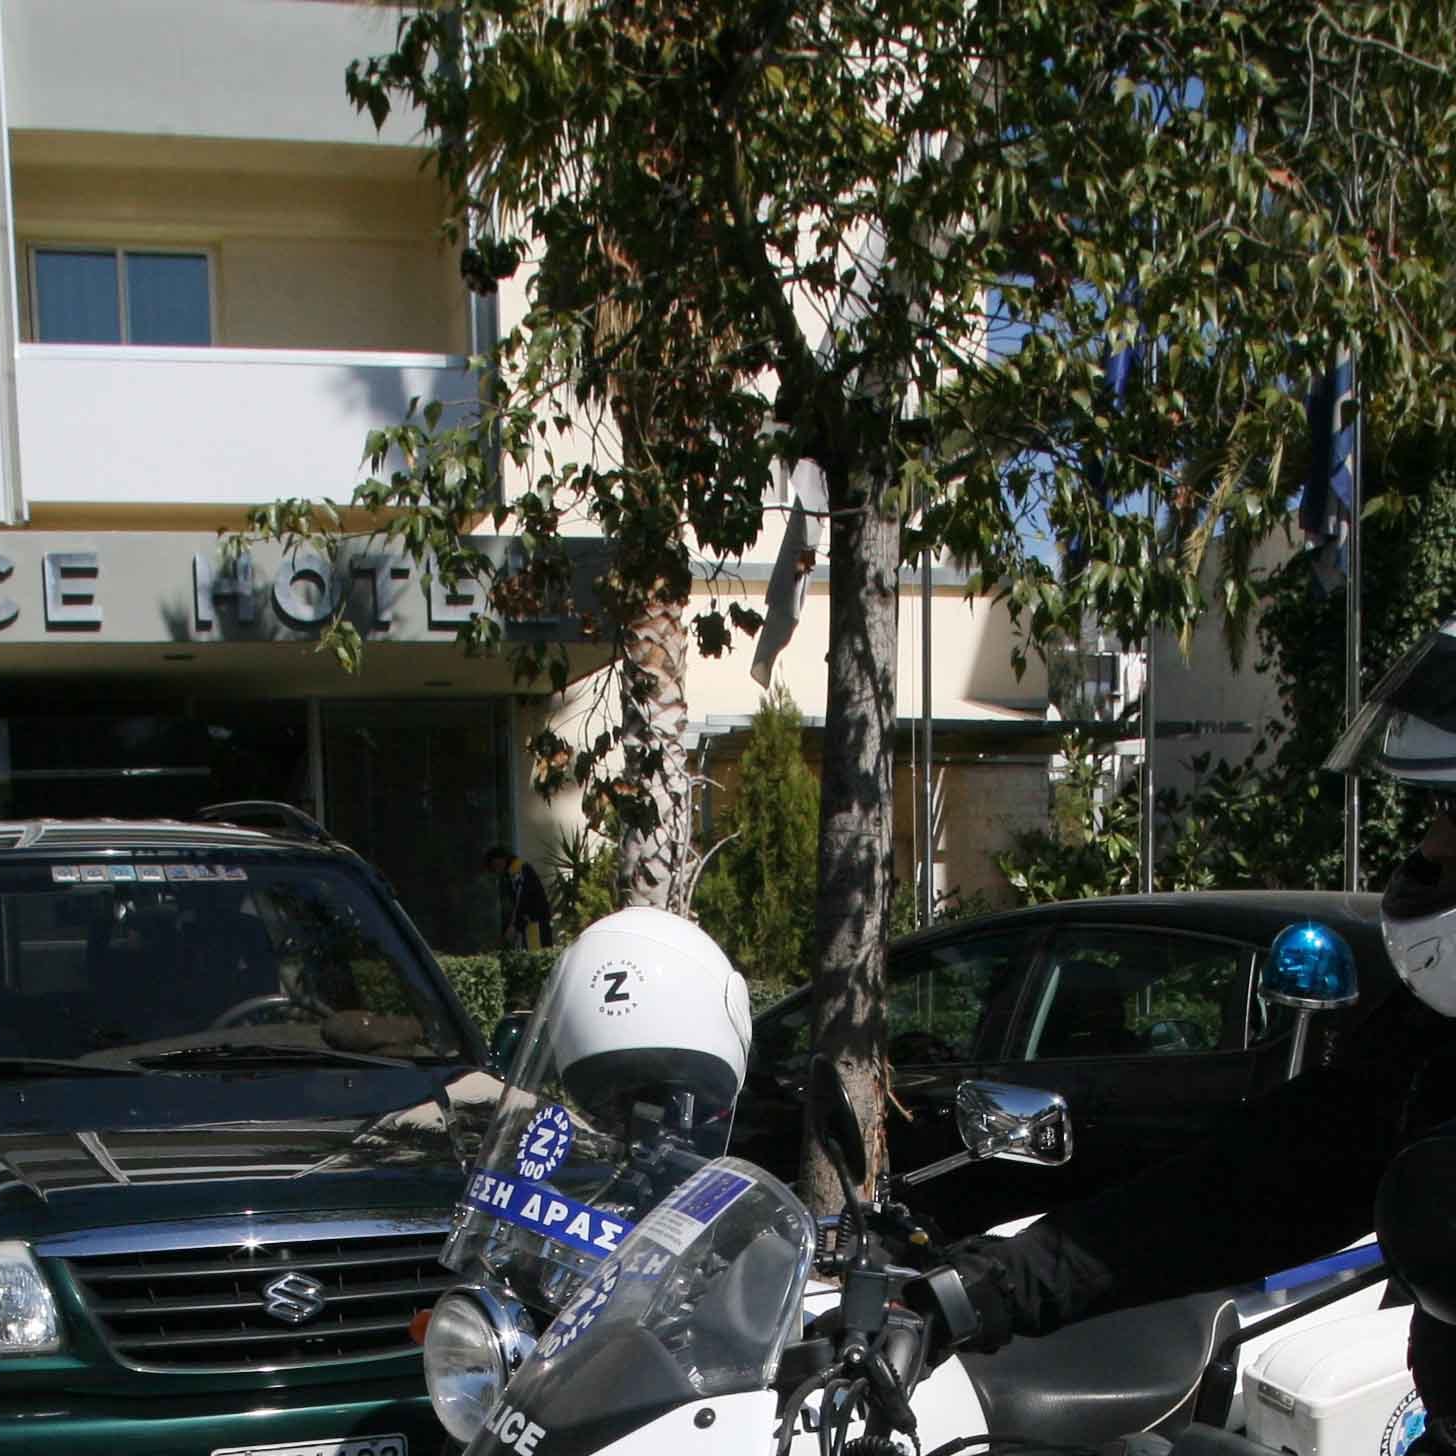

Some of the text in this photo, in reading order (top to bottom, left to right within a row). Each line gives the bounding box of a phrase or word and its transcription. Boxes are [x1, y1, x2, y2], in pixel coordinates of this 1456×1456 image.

[603, 970, 630, 1004] Z
[528, 1126, 556, 1158] Z
[518, 1159, 545, 1181] 100
[468, 1174, 515, 1210] ΕΣΗ
